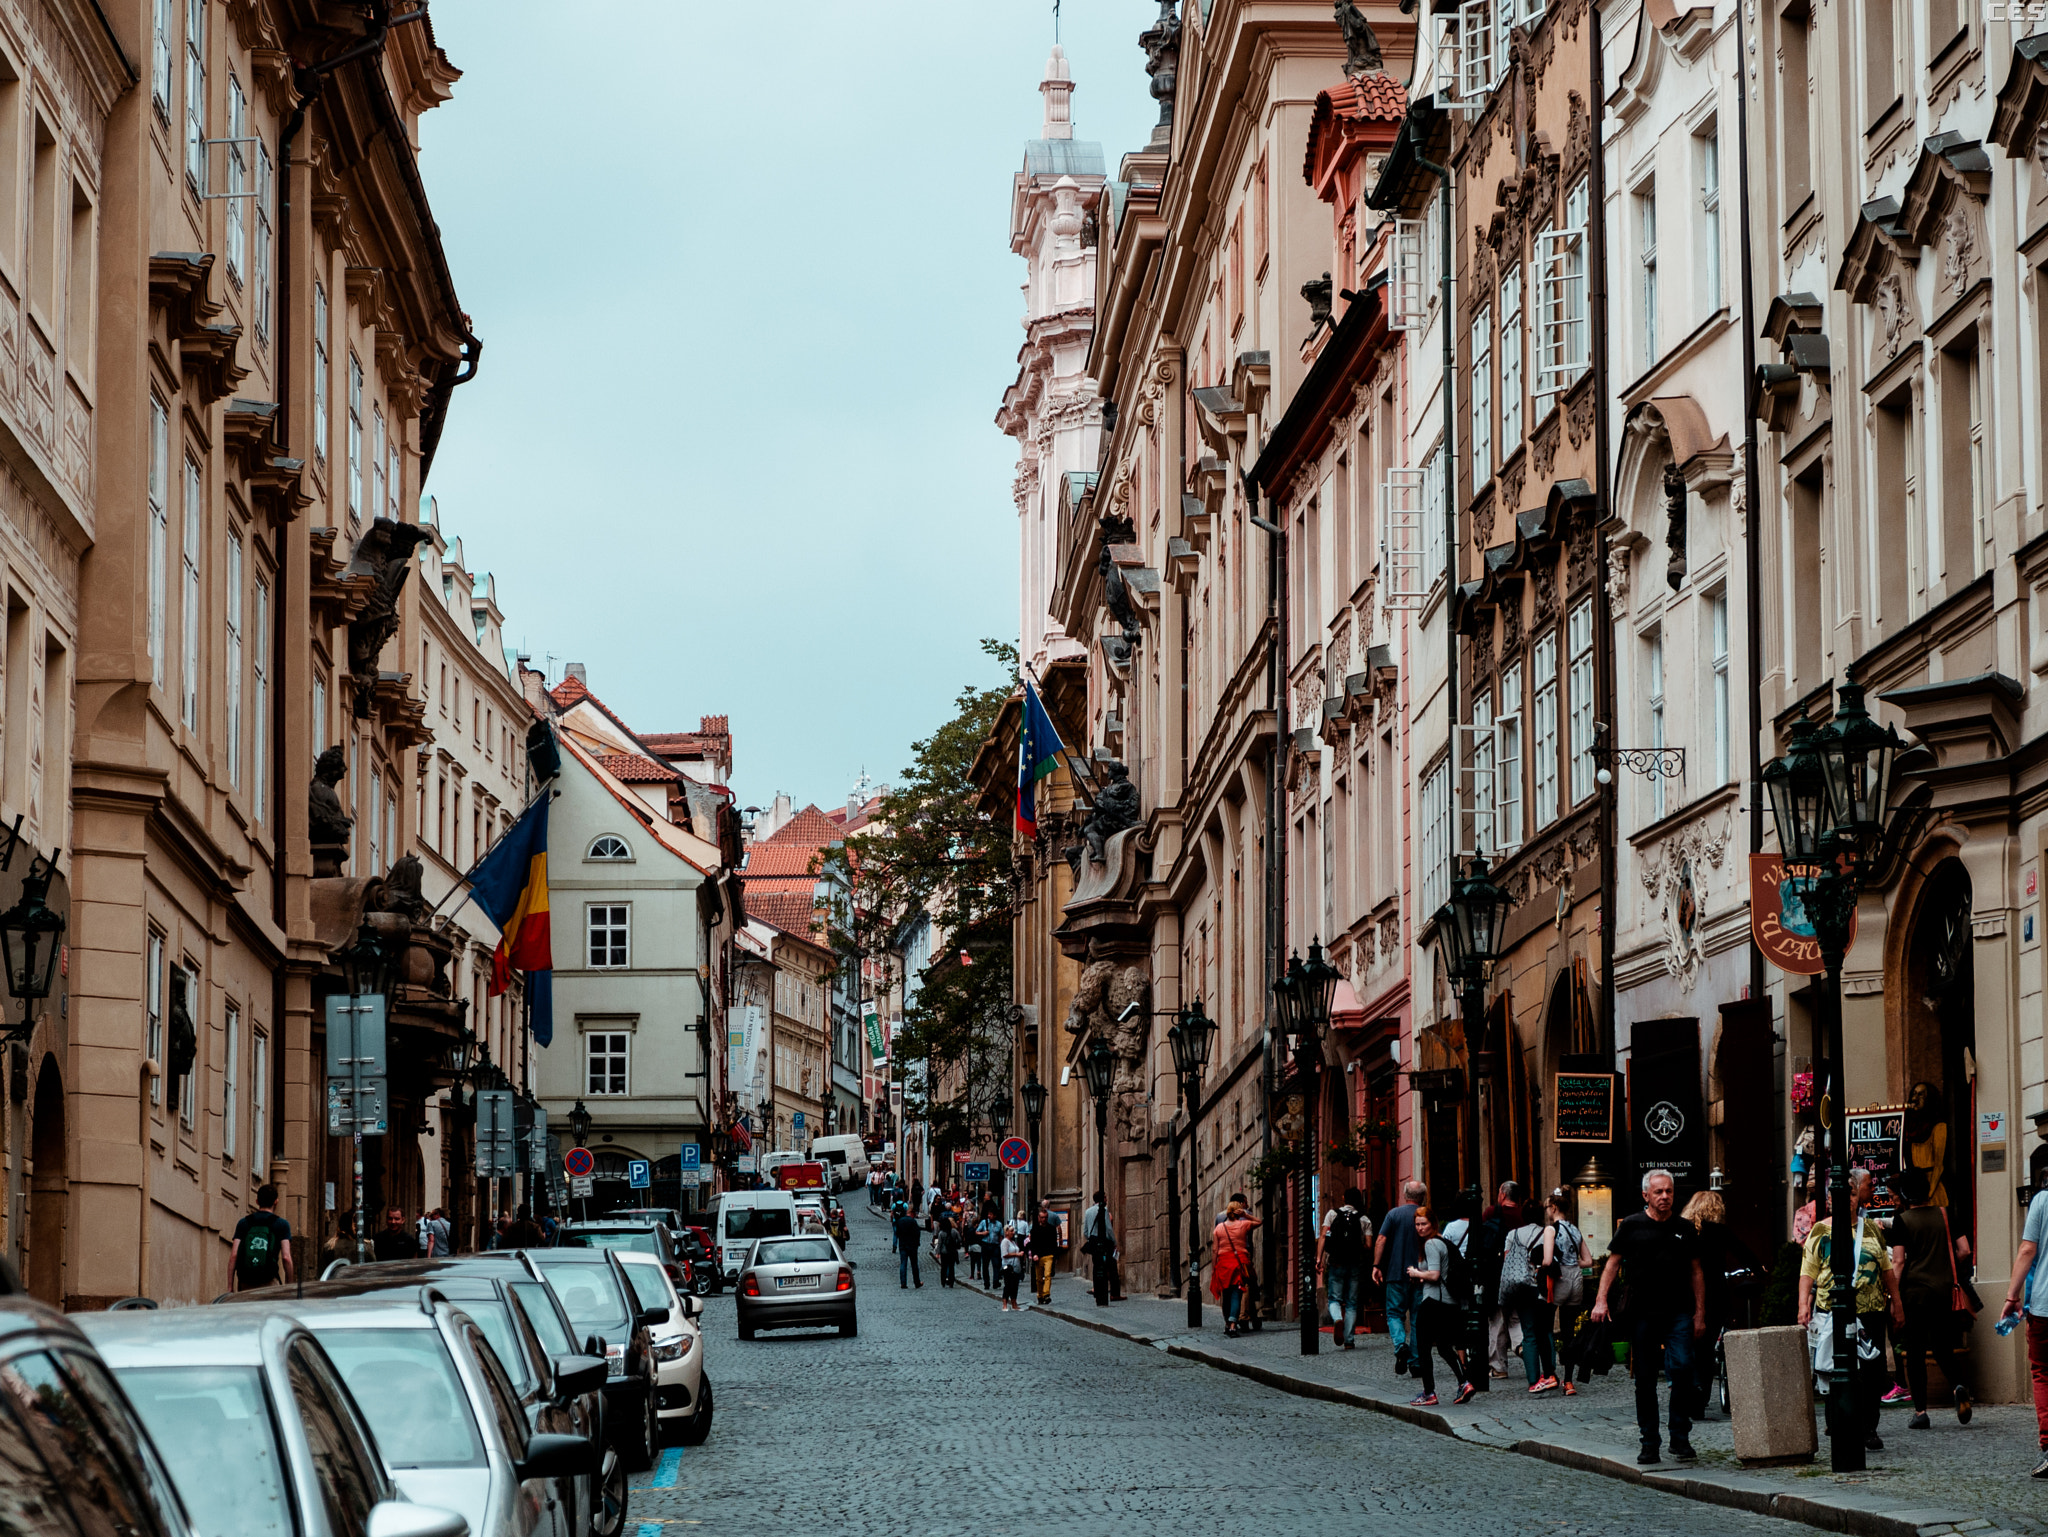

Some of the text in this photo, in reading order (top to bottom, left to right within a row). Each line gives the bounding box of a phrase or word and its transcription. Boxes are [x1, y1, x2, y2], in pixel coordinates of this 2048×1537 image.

[745, 1023, 753, 1048] GOLDEN
[867, 1026, 877, 1049] VEGAN
[872, 1020, 884, 1051] RESTAURANT
[1851, 1120, 1882, 1139] MENU
[685, 1147, 696, 1162] P
[1856, 1143, 1876, 1156] Potato
[1876, 1142, 1894, 1157] Soup
[632, 1164, 645, 1180] P
[1646, 1160, 1656, 1168] TŘÍ
[1656, 1160, 1693, 1168] HOUSLIČEK
